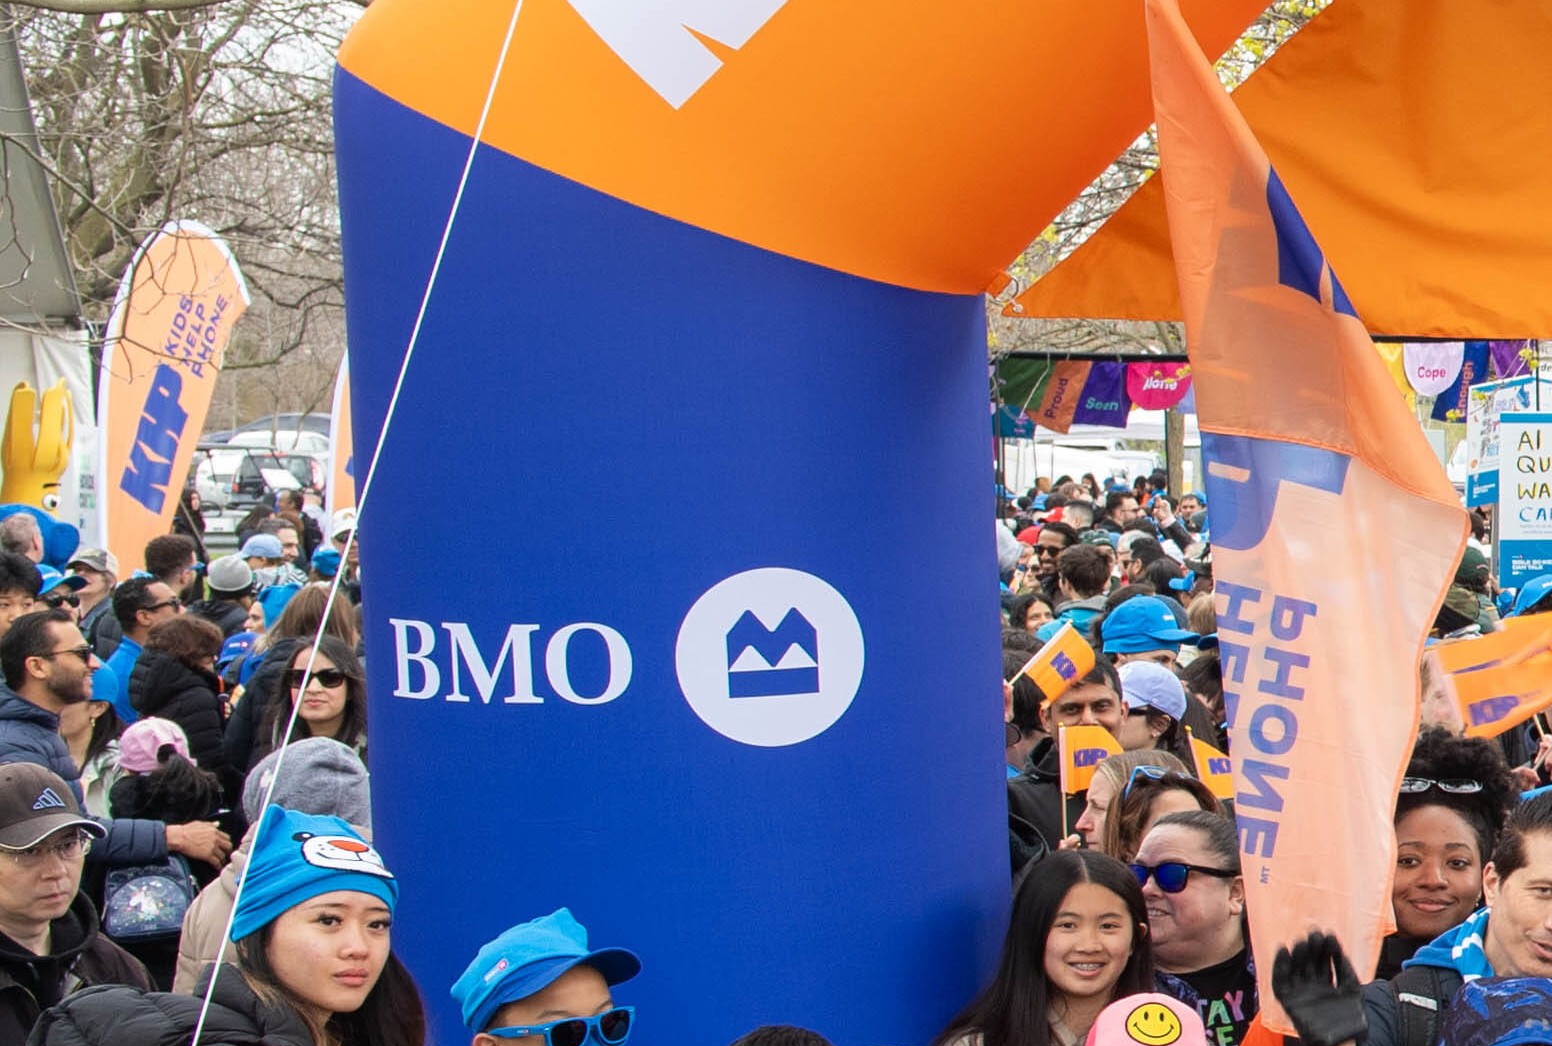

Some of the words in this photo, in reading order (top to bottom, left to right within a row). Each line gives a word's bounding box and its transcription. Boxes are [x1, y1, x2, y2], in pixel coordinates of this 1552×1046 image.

[164, 295, 194, 357] KIDS
[1044, 377, 1068, 419] Proud
[1416, 366, 1447, 381] Cope
[119, 362, 189, 515] KHP
[1517, 429, 1542, 451] AI
[389, 618, 633, 704] BMO
